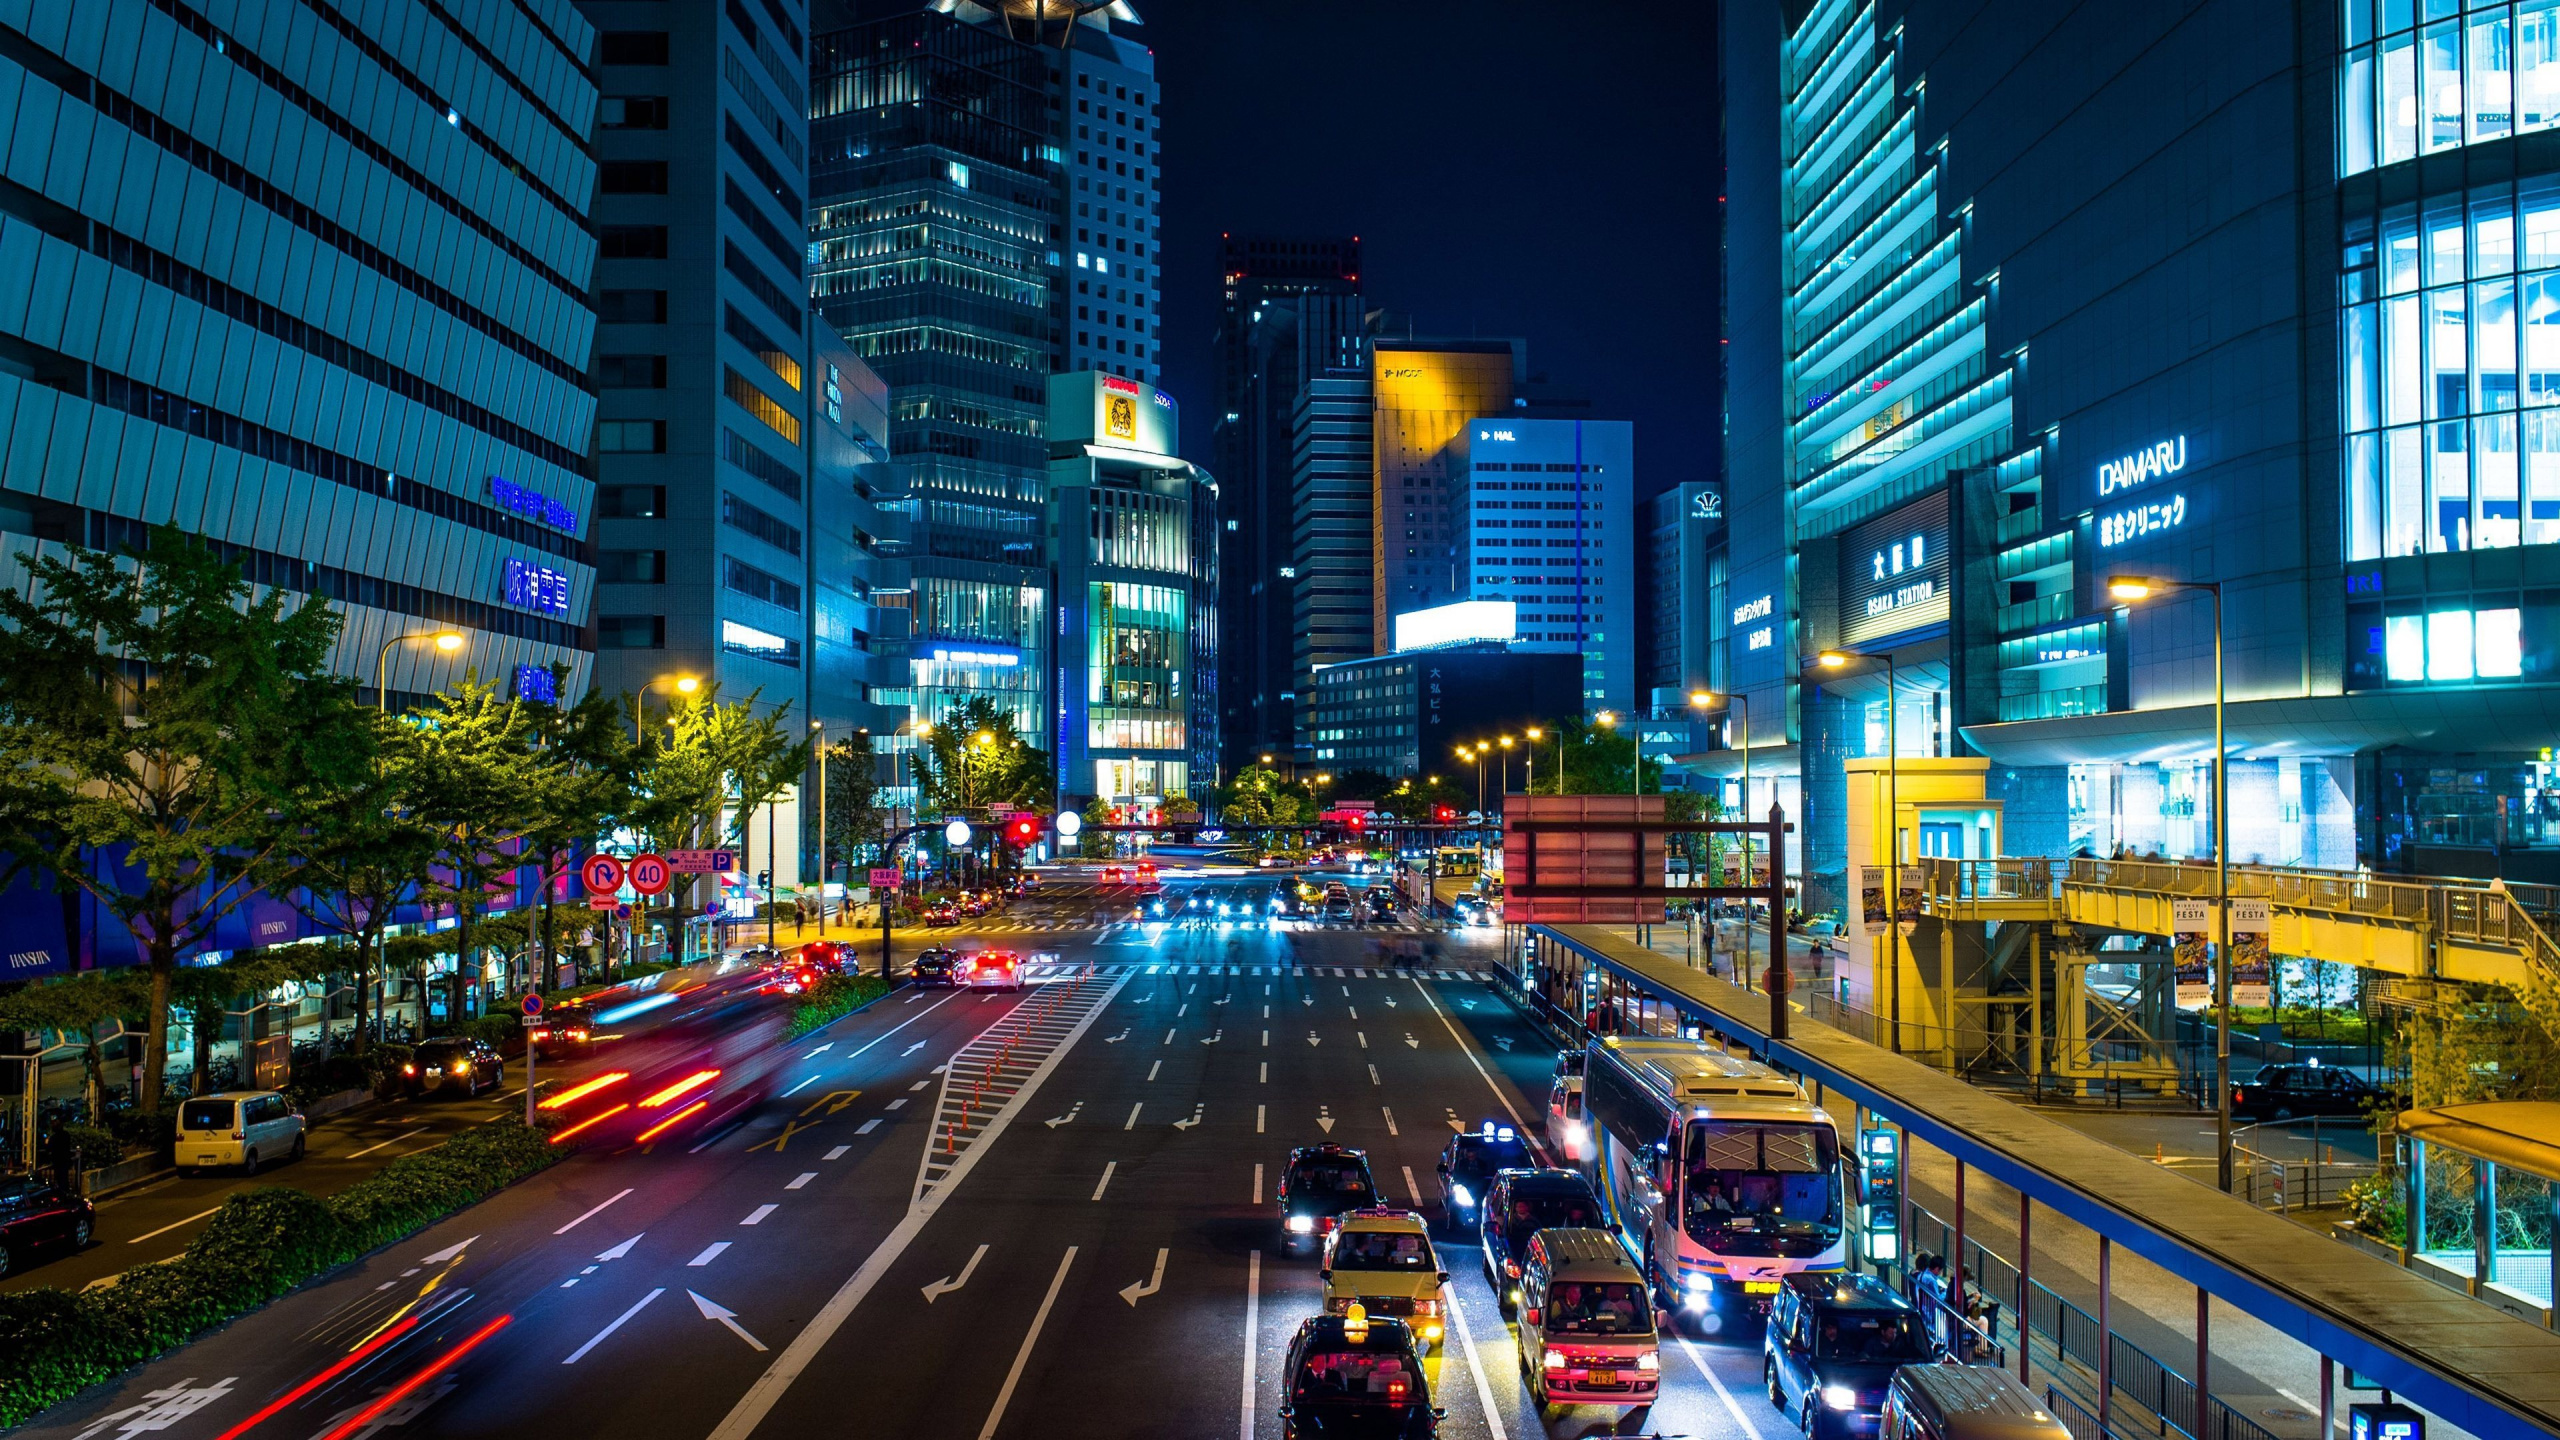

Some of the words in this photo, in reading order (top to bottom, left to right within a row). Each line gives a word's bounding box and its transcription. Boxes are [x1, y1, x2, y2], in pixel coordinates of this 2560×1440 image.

[1493, 431, 1516, 441] HAL
[2100, 435, 2185, 496] DAIMARU
[508, 559, 567, 616] 阪神電車
[1867, 593, 1893, 616] OSAKA
[1897, 580, 1932, 608] STATION
[1430, 668, 1441, 724] 大弘ビル
[717, 854, 728, 869] P
[638, 866, 660, 883] 40
[883, 891, 890, 900] P
[2176, 911, 2205, 919] FESTA
[2236, 911, 2265, 919] FESTA
[261, 920, 288, 936] HANSHIN
[10, 950, 51, 968] HANSHIN
